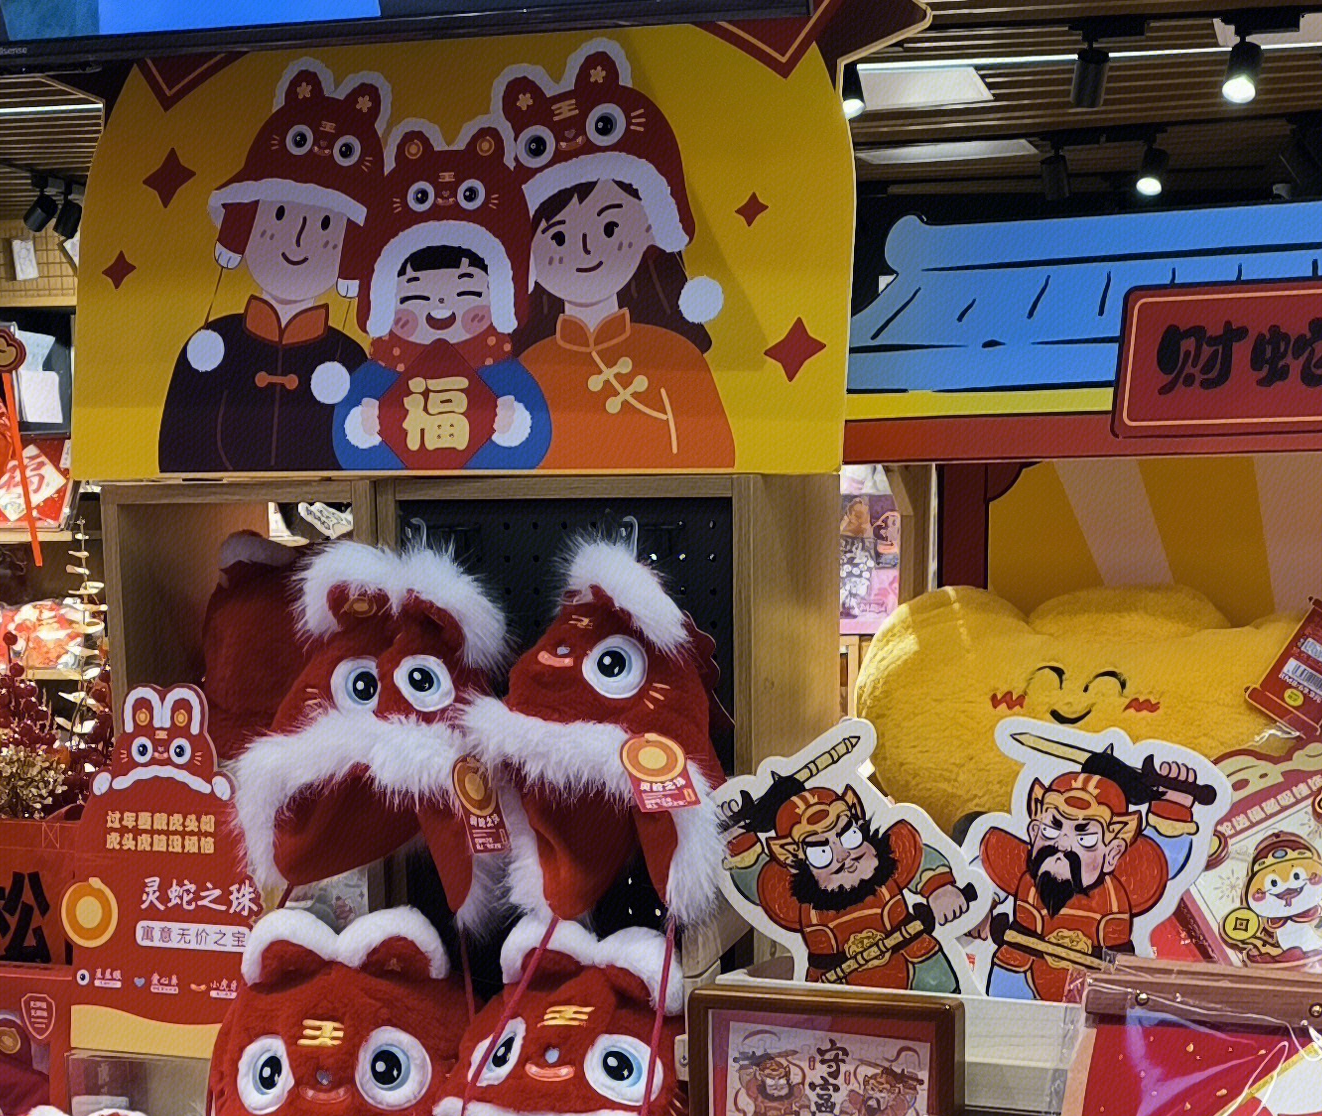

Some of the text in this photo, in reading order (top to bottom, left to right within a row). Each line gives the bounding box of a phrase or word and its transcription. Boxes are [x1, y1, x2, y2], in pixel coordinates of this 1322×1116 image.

[404, 377, 470, 450] 福
[140, 877, 258, 917] 灵蛇之珠
[141, 926, 246, 948] 寓意无价之宝
